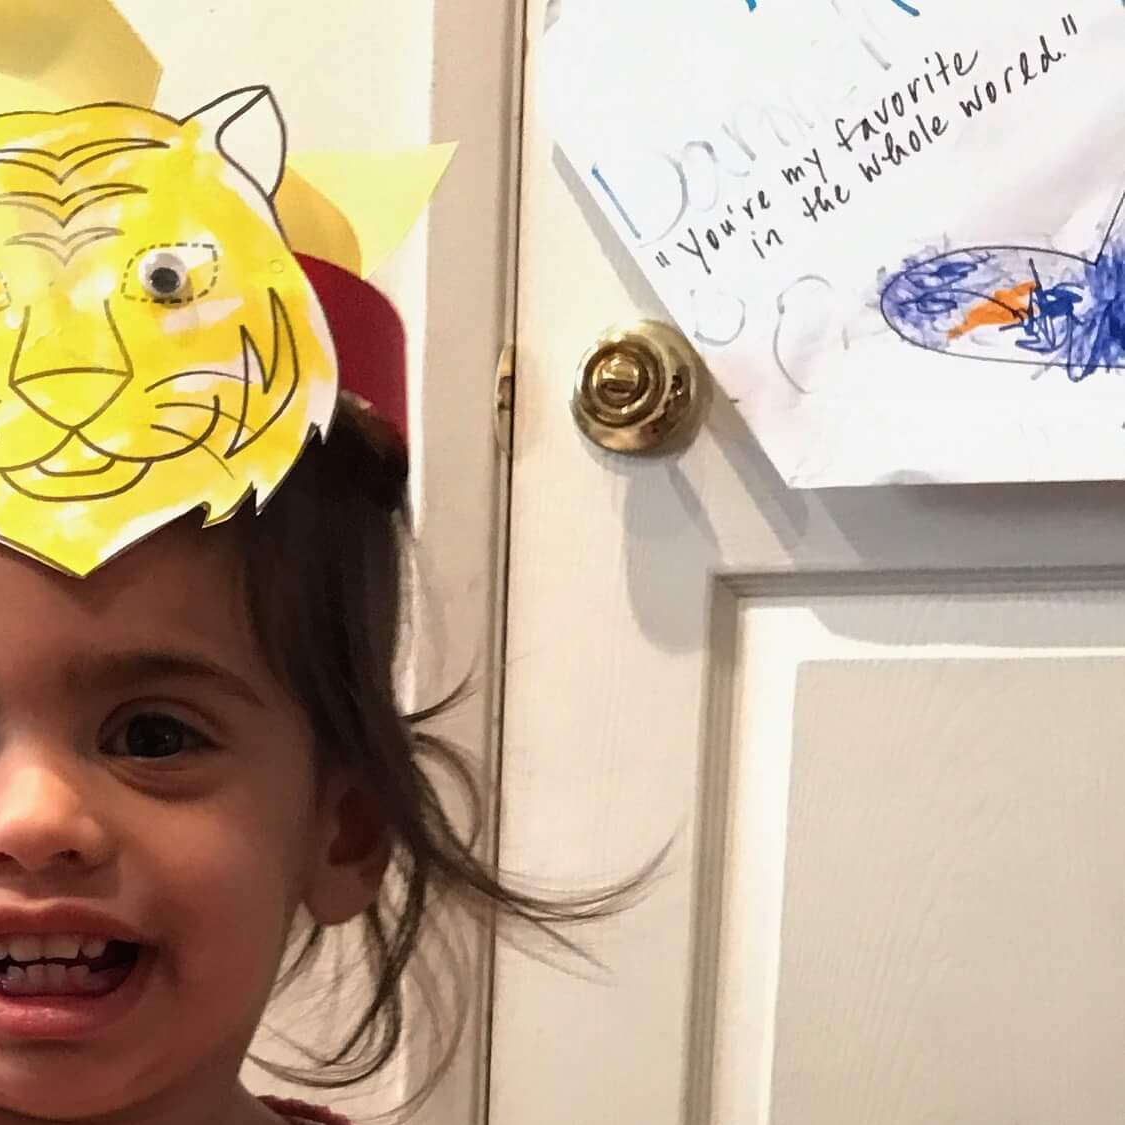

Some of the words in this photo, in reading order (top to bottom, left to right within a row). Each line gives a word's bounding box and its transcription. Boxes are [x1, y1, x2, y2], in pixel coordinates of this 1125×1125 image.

[750, 227, 784, 260] in
[802, 184, 851, 223] the
[858, 113, 949, 183] whole
[781, 148, 828, 185] my
[834, 49, 979, 152] favorite
